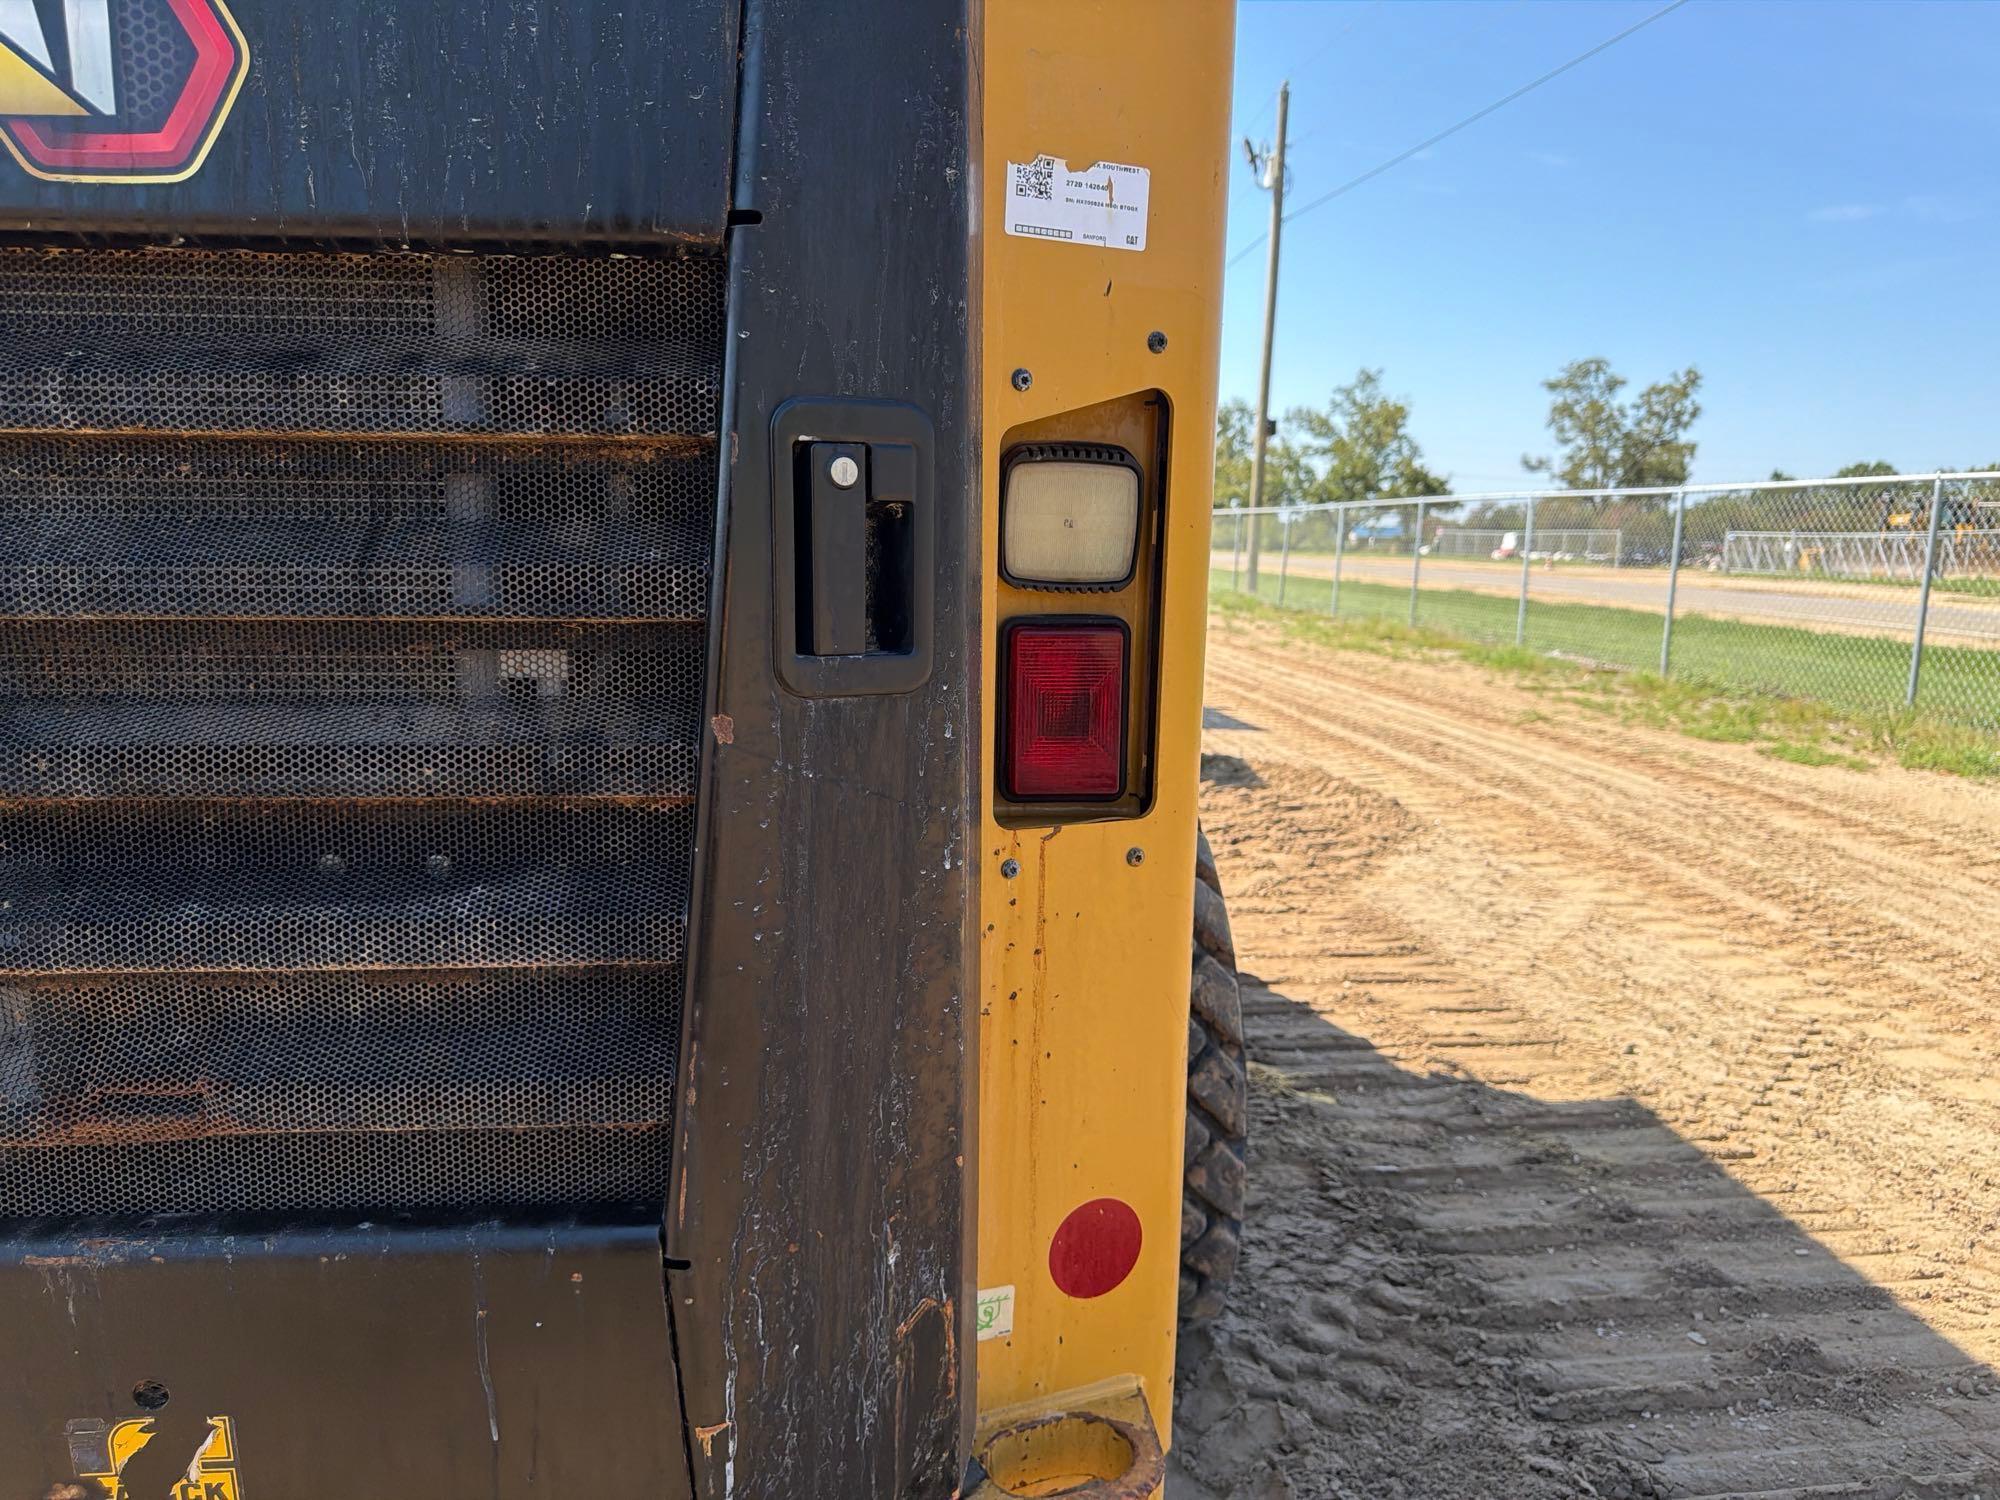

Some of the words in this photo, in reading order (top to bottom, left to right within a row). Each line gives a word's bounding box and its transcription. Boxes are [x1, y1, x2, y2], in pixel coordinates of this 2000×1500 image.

[1103, 164, 1140, 174] SOUTHWEST
[1066, 180, 1082, 188] 272D
[1126, 235, 1138, 245] CAT
